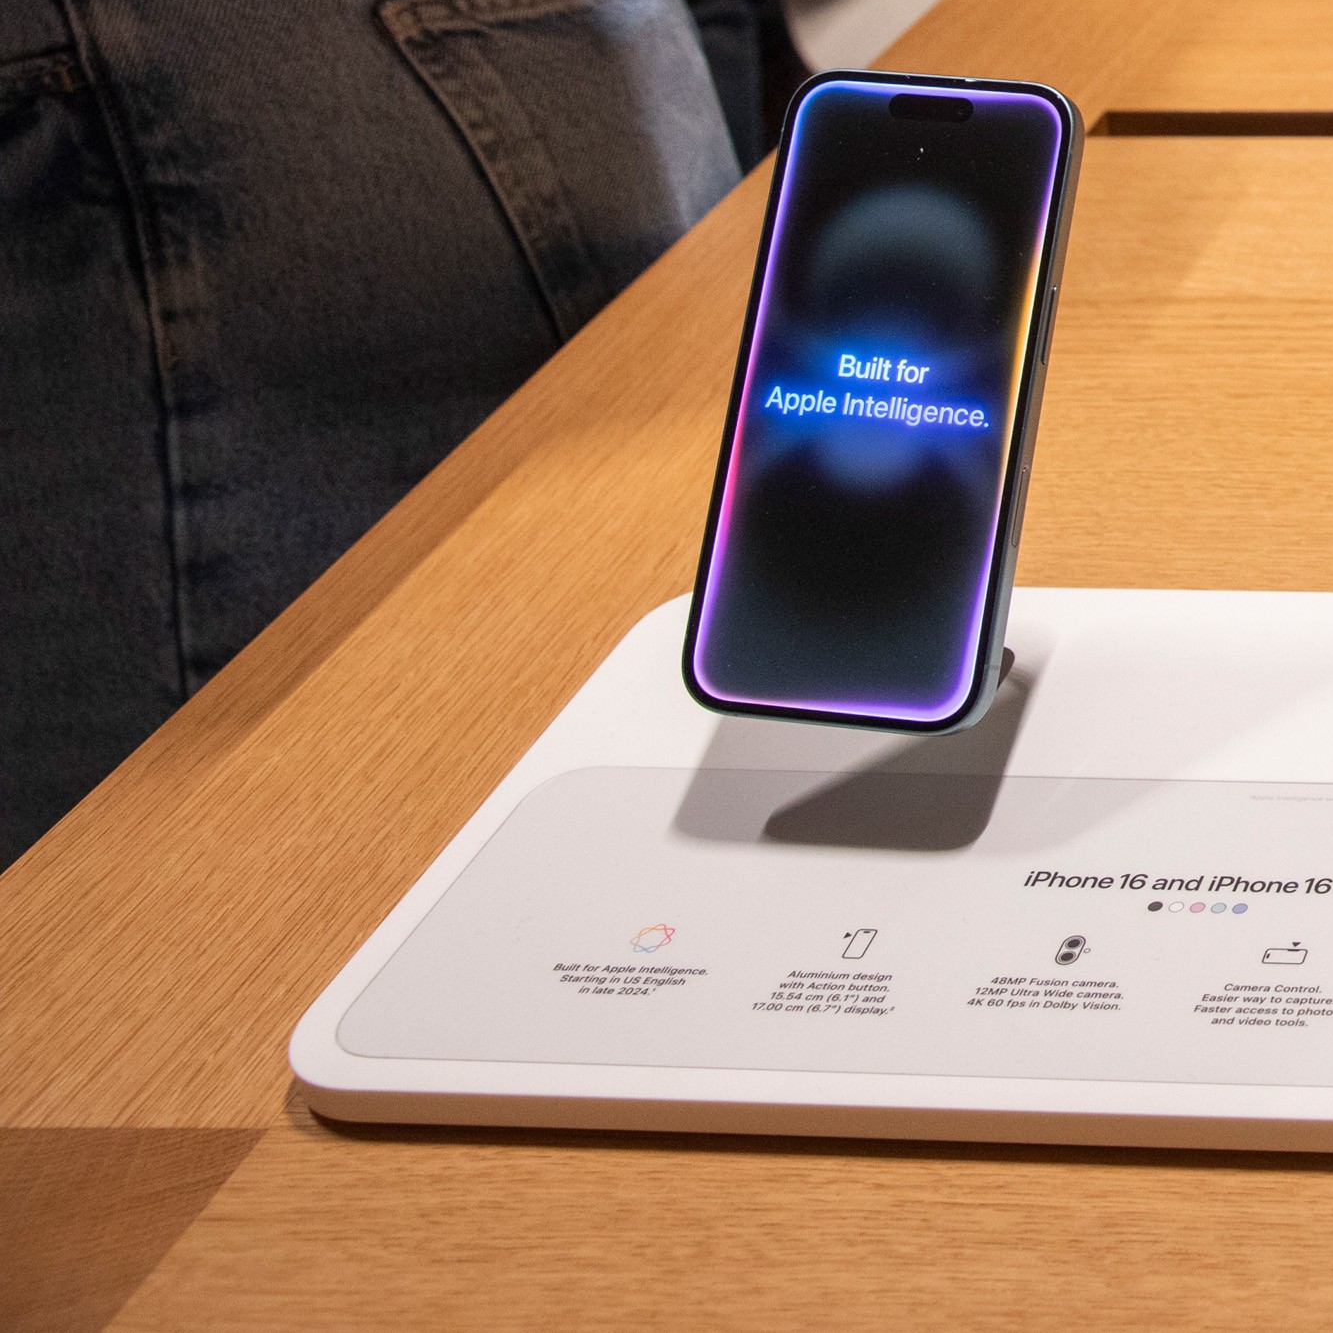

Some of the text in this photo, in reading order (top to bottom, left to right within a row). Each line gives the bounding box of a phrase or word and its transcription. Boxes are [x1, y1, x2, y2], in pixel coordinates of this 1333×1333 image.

[837, 354, 930, 384] Built for
[764, 385, 988, 428] Apple Intelligence.
[1023, 869, 1114, 889] iPhone
[1119, 871, 1148, 890] 16
[1151, 872, 1204, 891] and
[1207, 873, 1299, 893] iPhone
[1304, 875, 1333, 894] 16
[552, 963, 707, 976] Built for Apple Intelligence.
[559, 974, 686, 987] Starting in US English
[786, 970, 892, 982] Aluminium design
[990, 976, 1118, 988] 48MP Fusion camera.
[577, 986, 590, 994] in
[591, 986, 615, 995] late
[779, 981, 889, 992] with Action button.
[975, 987, 1008, 996] 12MP
[1010, 988, 1040, 997] Ultra
[1043, 989, 1073, 998] Wide
[770, 991, 802, 1001] 15.54
[861, 994, 886, 1003] and
[752, 1002, 783, 1012] 17.00
[966, 998, 1120, 1011] 4K 60 fps in Dolby Vision.
